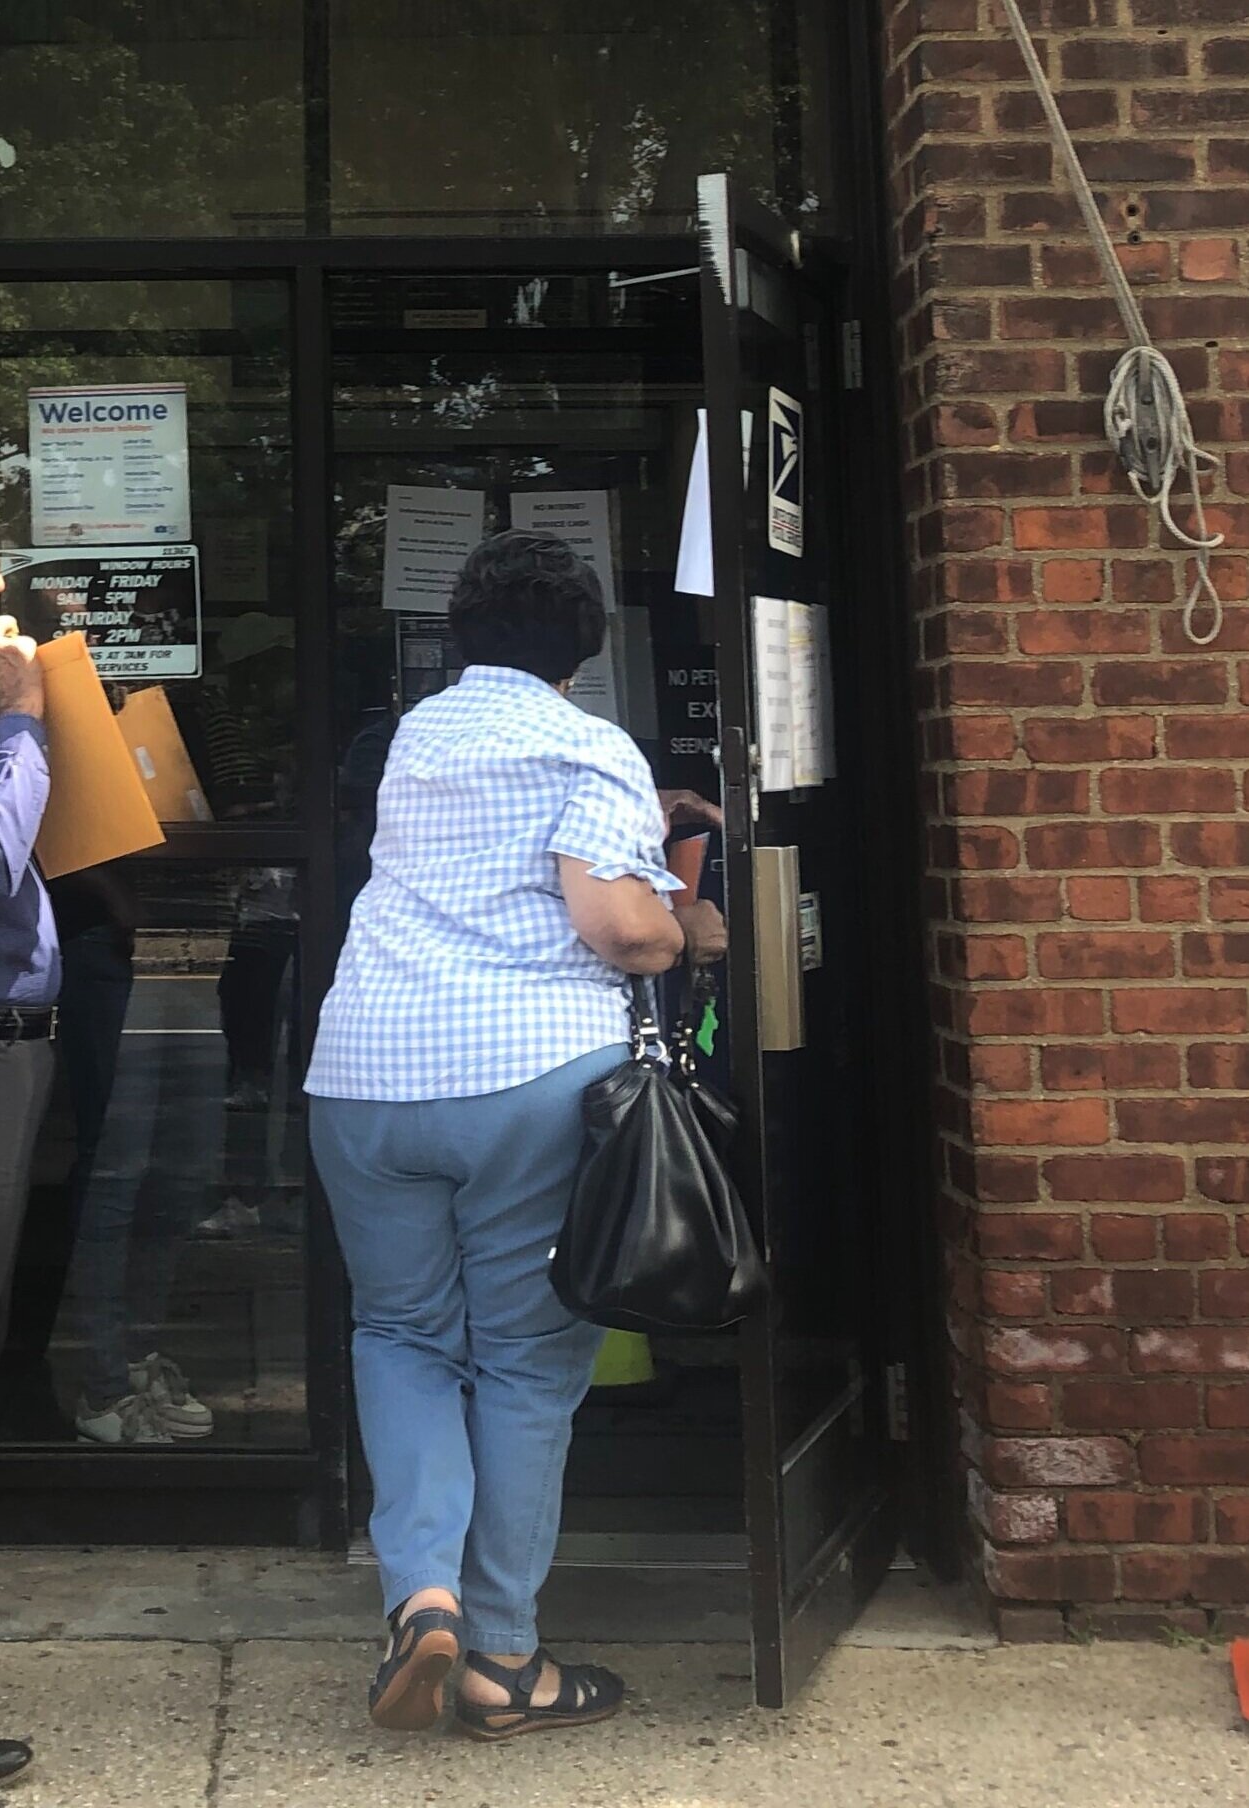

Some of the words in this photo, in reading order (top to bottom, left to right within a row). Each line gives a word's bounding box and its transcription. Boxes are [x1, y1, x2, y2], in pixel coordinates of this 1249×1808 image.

[38, 400, 168, 424] Welcome
[100, 560, 150, 570] WINDOW
[151, 560, 192, 570] HOURS
[30, 576, 94, 590] MONDAY
[110, 574, 164, 588] FRIDAY
[56, 592, 88, 606] 9AM
[104, 591, 138, 604] 5PM
[60, 610, 134, 626] SATURDAY
[104, 628, 142, 643] 2PM
[106, 650, 120, 660] AT
[150, 650, 172, 659] FOR
[96, 662, 150, 672] SERVICES
[668, 669, 688, 686] NO
[691, 669, 717, 686] PET
